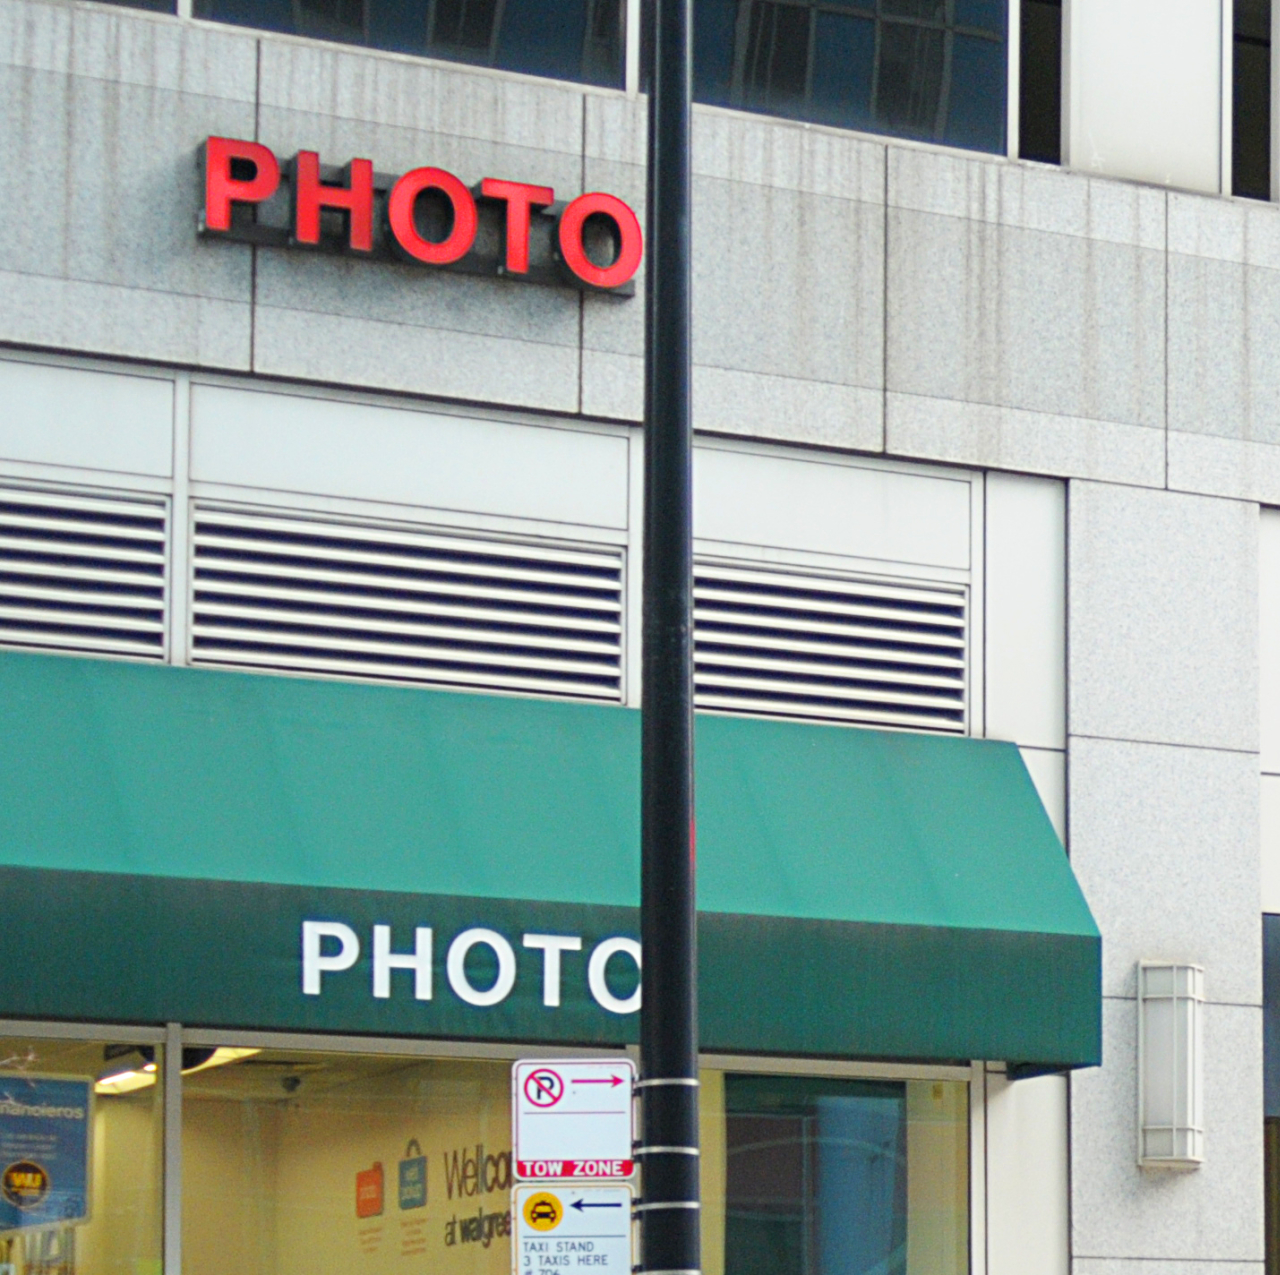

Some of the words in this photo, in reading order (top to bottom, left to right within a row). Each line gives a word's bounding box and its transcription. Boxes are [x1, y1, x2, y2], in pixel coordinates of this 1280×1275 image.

[203, 135, 645, 290] PHOTO
[301, 919, 641, 1014] PHOTO
[522, 1160, 564, 1177] TOW
[572, 1160, 625, 1176] ZONE
[444, 1212, 457, 1247] at
[459, 1206, 512, 1249] walgree
[523, 1242, 553, 1253] TAXI
[556, 1241, 595, 1252] STAND
[523, 1255, 531, 1267] 3
[538, 1255, 571, 1266] TAXIS
[577, 1254, 609, 1266] HERE
